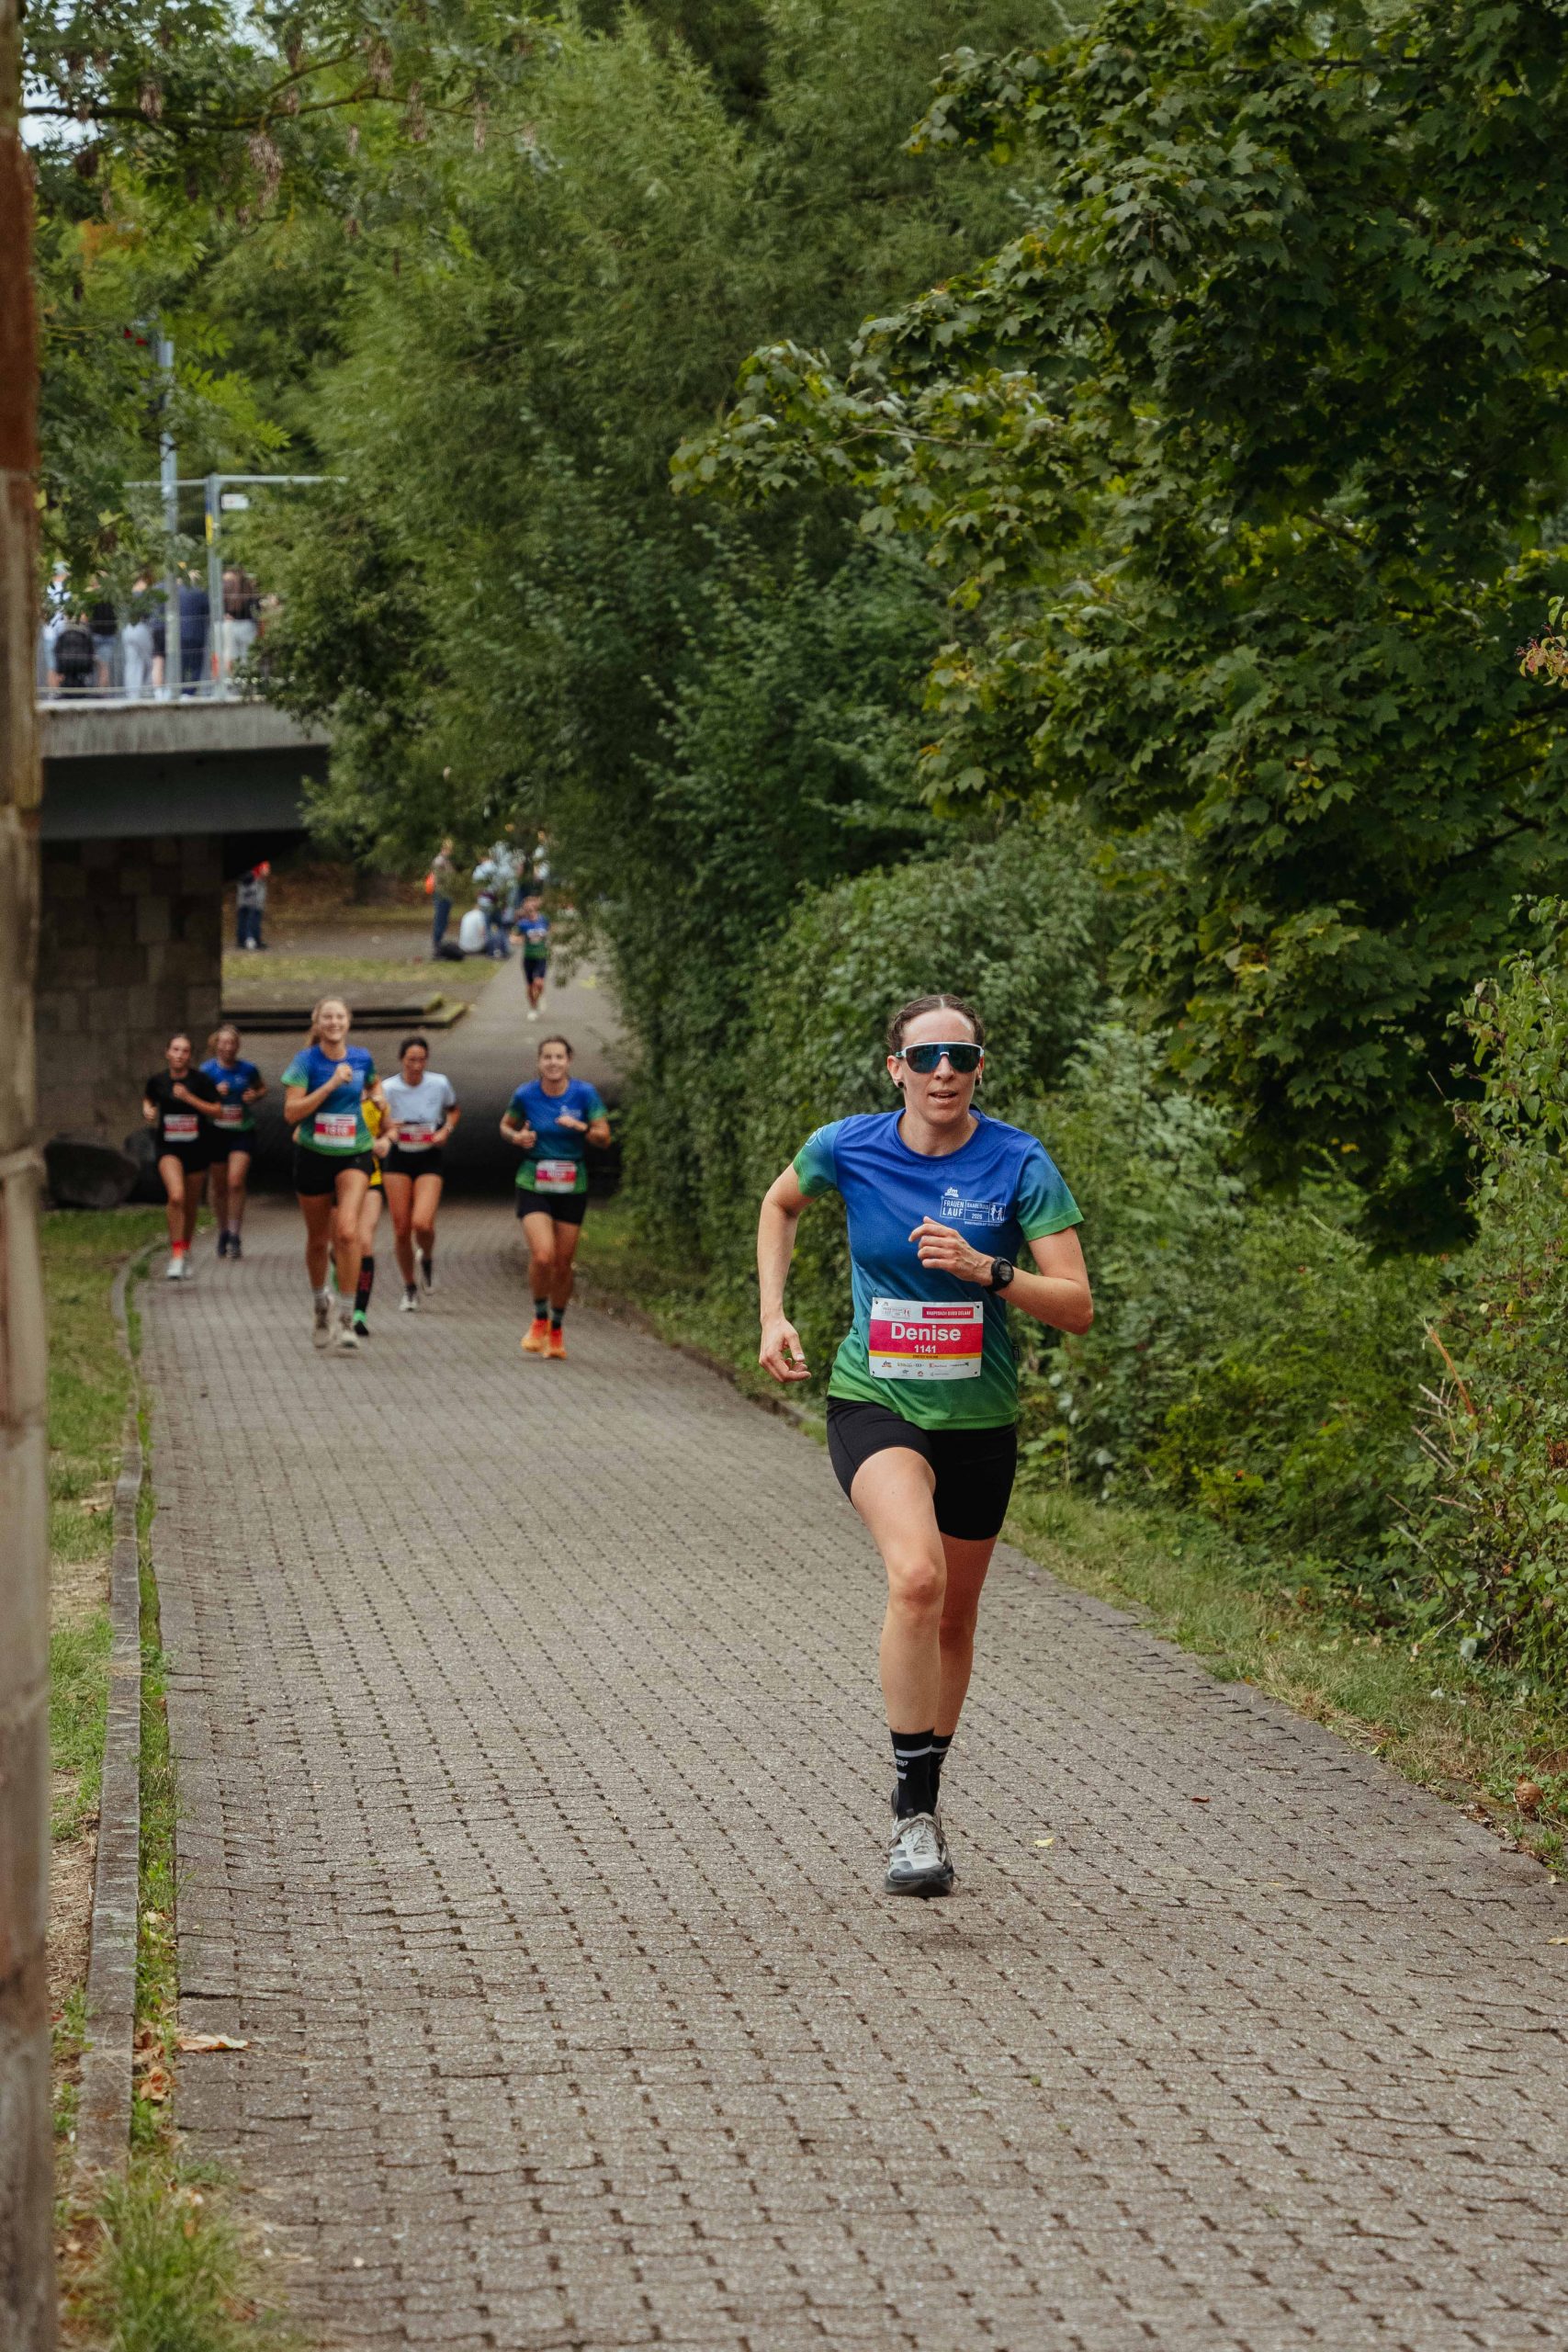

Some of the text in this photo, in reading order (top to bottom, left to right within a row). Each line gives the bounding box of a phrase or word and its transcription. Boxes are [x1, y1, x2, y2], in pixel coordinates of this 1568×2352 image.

[943, 1200, 964, 1208] FRAUEN
[942, 1207, 964, 1217] LAUF
[891, 1323, 961, 1341] Denise
[914, 1345, 936, 1353] 1141
